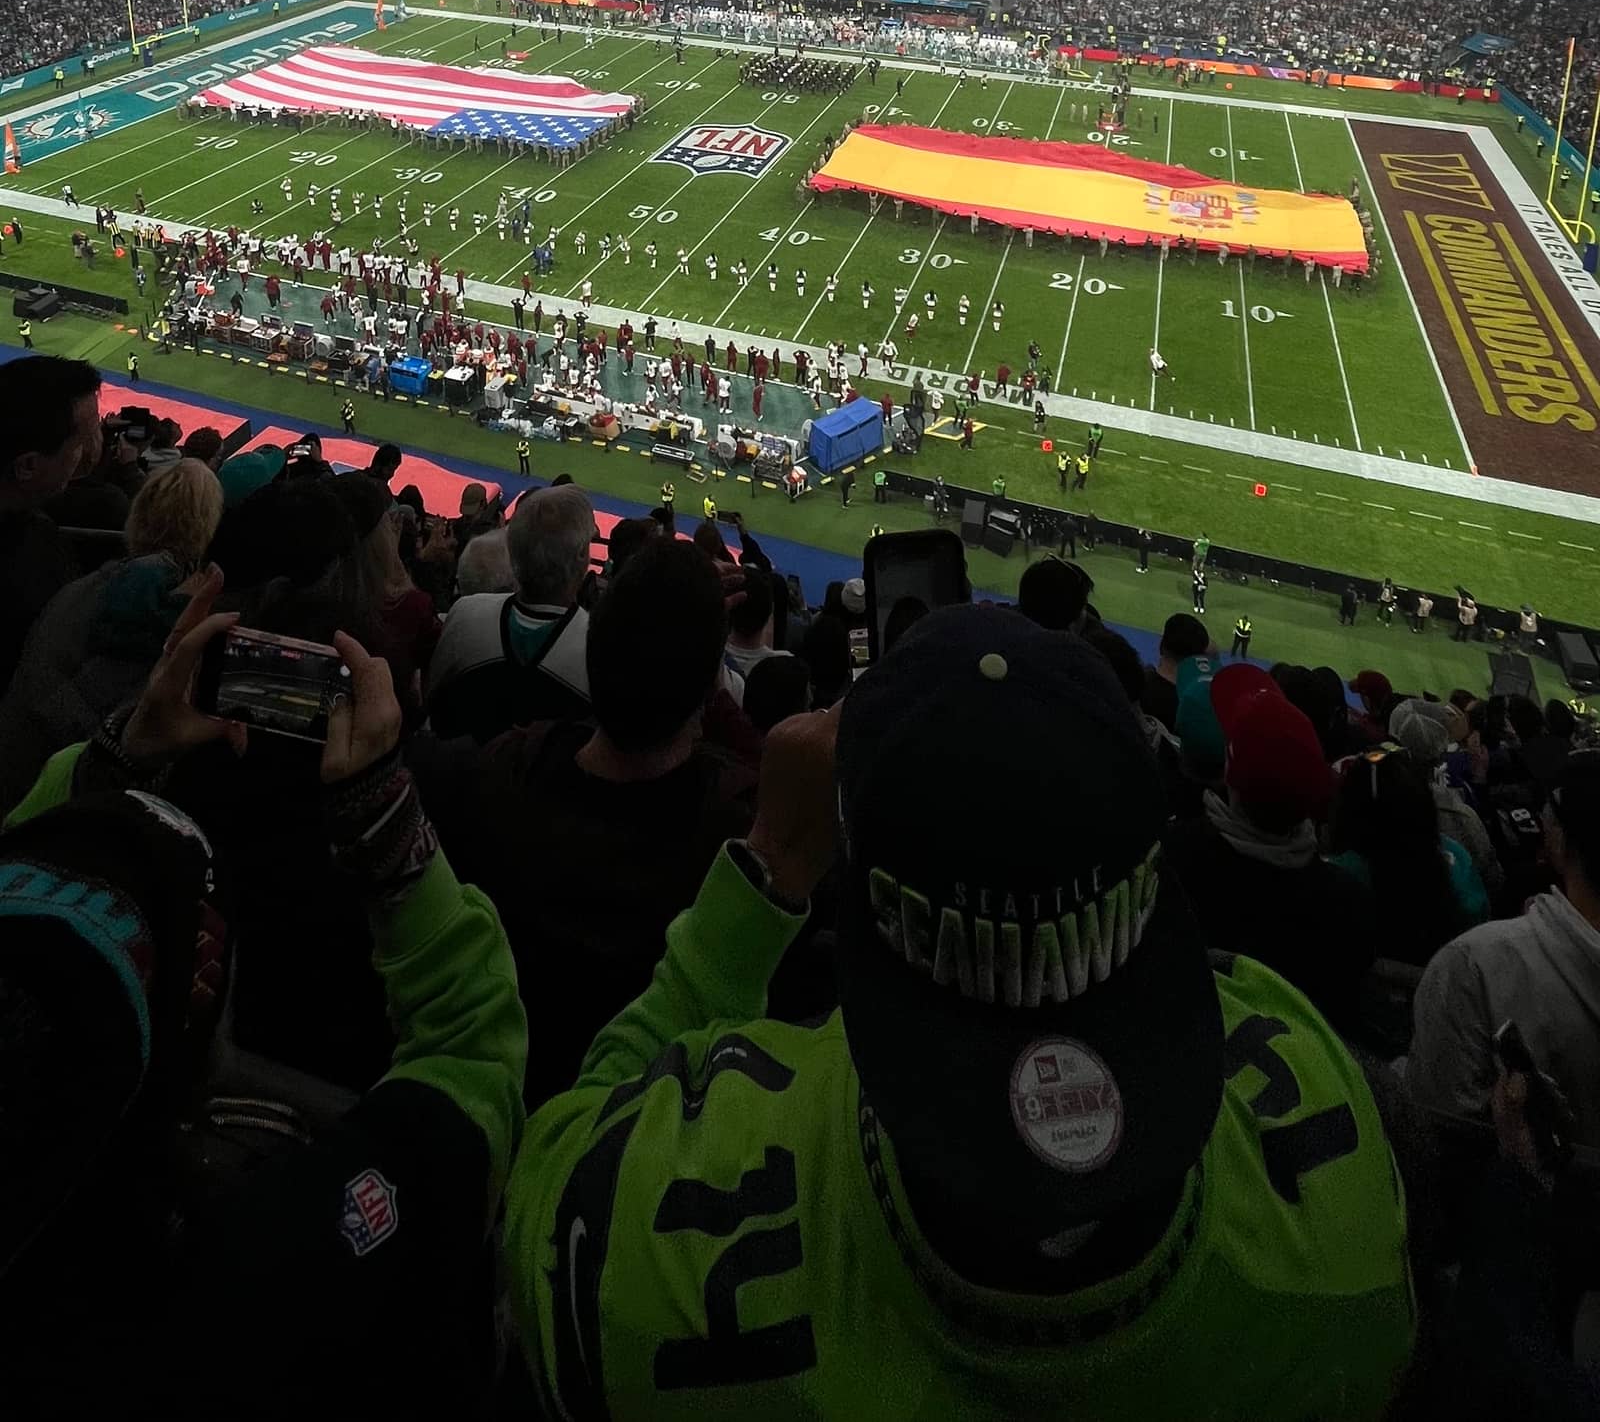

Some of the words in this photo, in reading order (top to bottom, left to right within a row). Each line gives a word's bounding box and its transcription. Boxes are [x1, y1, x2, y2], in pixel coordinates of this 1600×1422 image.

[136, 21, 358, 102] Dolphins
[761, 91, 801, 104] 50
[972, 117, 1016, 131] 30
[203, 136, 239, 150] 10
[694, 129, 780, 157] NFL
[1087, 131, 1130, 145] 20
[298, 150, 337, 166] 20
[402, 168, 443, 184] 30
[510, 185, 557, 203] 40
[628, 205, 678, 224] 50
[1518, 203, 1543, 216] IT
[759, 227, 812, 246] 40
[1528, 220, 1574, 260] TAKES
[899, 248, 952, 269] 30
[1049, 272, 1107, 295] 20
[1560, 265, 1595, 292] ALL
[1221, 299, 1275, 324] 10
[1424, 214, 1597, 432] COMMANDERS
[953, 866, 1102, 921] SEATTLE
[356, 1177, 392, 1235] NFL
[653, 1145, 818, 1391] 14
